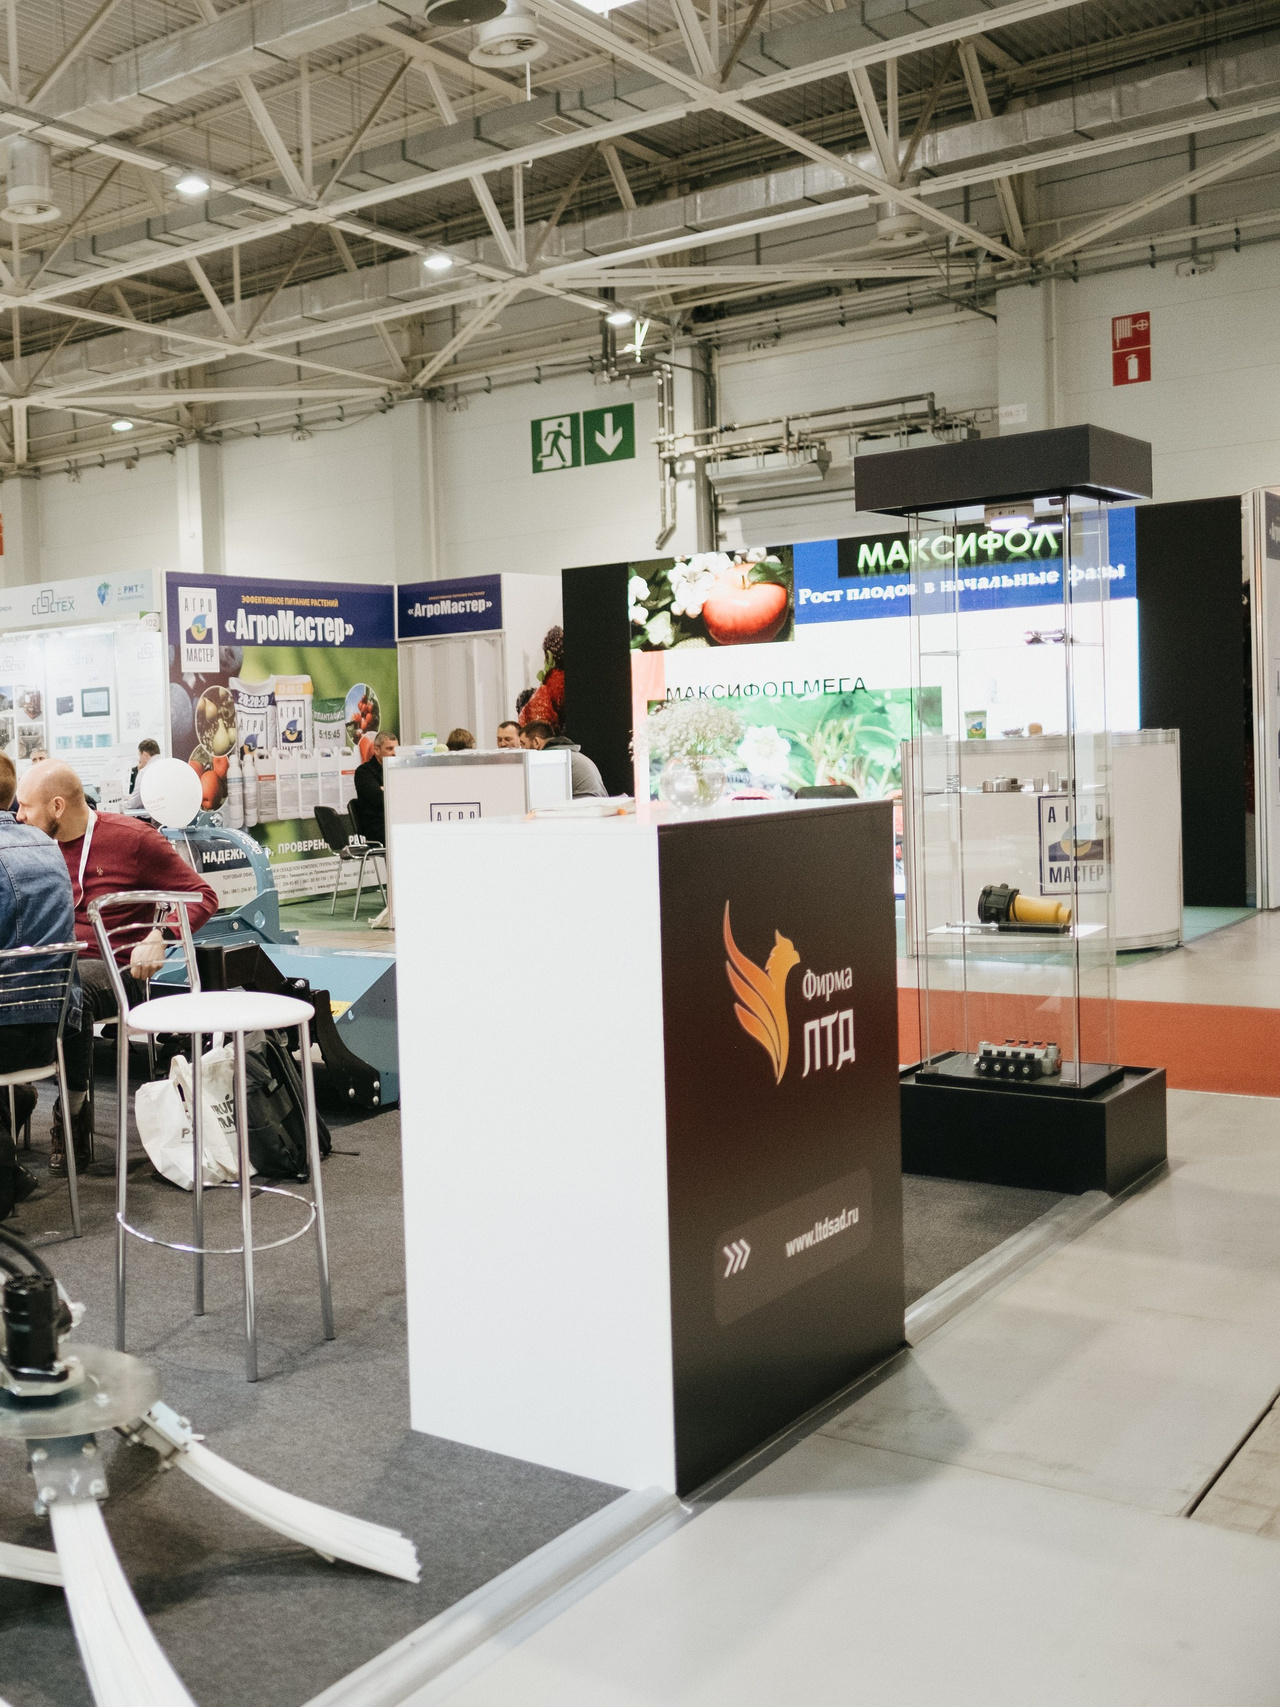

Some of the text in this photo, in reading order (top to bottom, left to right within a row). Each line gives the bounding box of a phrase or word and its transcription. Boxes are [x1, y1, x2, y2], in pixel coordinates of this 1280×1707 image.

[857, 525, 1059, 568] МАКСИФОЛ
[798, 563, 1126, 605] Рост плодов в начальные фазы
[184, 597, 213, 613] АГРО
[241, 595, 339, 608] ЭФФЕКТИВНОЕ ПИТАНИЕ РАСТЕНИЙ
[407, 599, 493, 618] «АгроМастер»
[225, 608, 354, 645] «АгроМастер»
[186, 647, 215, 663] МАСТЕР
[803, 677, 868, 696] МЕГА
[238, 692, 269, 708] 20:20:20
[280, 706, 303, 718] АГРО
[238, 718, 264, 732] АГРО
[318, 729, 341, 740] 5:15:45
[803, 967, 853, 1002] Фирма
[802, 1008, 856, 1079] ЛТД
[785, 1207, 860, 1258] www.ltdsad.ru
